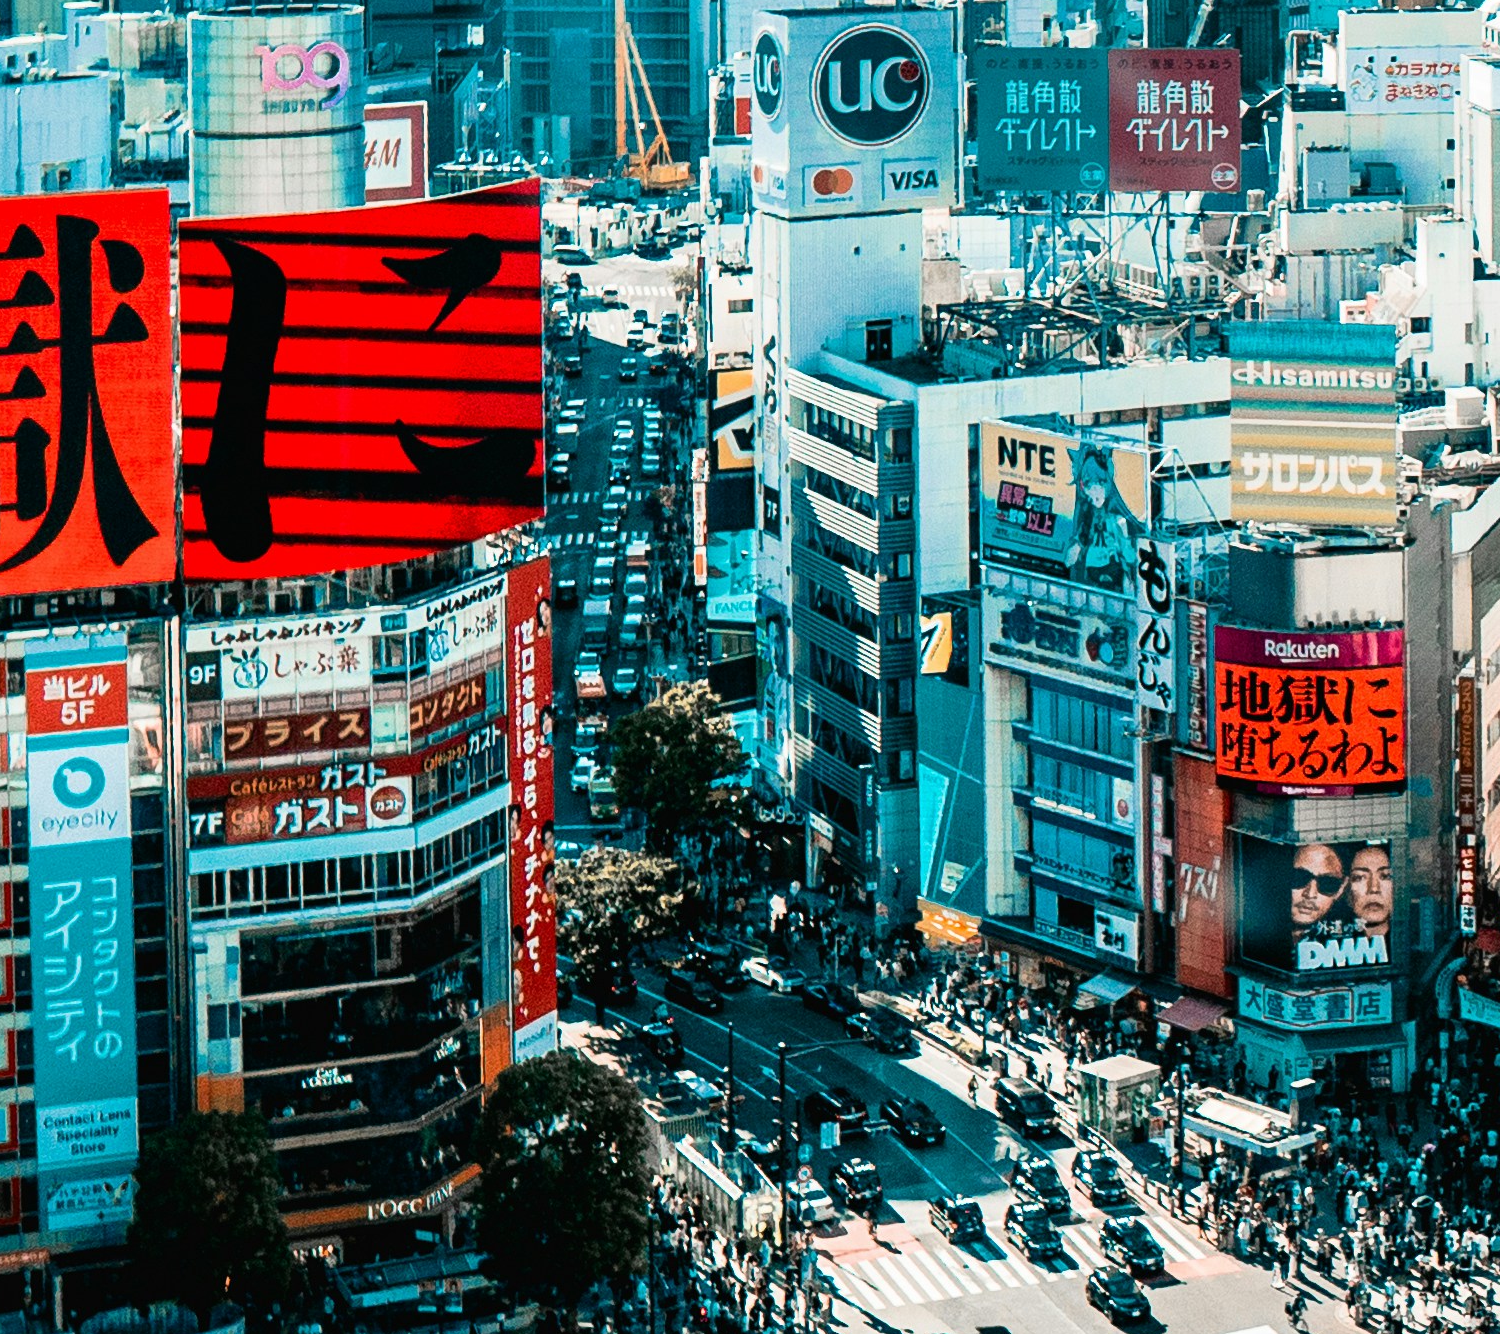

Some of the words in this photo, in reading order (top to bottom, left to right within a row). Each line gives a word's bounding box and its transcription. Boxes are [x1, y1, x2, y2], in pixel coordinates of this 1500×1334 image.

[254, 41, 350, 112] 109
[1395, 62, 1454, 76] カラオケ
[1005, 79, 1082, 115] 龍角散
[1136, 79, 1215, 115] 龍角散
[995, 117, 1097, 152] ダイレクト
[1125, 117, 1231, 152] ダイレクト
[888, 169, 939, 191] VISA
[1232, 360, 1393, 389] Hisamitsu
[205, 231, 540, 564] に
[998, 436, 1056, 478] NTE
[1240, 451, 1387, 496] サロンパス
[210, 617, 366, 647] しゃぶしゃぶバイキング
[453, 603, 498, 647] しゃぶ葉
[1137, 539, 1172, 709] もんじゃ
[274, 644, 362, 679] しゃぶ葉
[1264, 639, 1340, 660] Rakuten
[43, 673, 112, 701] 当ビル
[189, 664, 217, 685] 9F
[60, 699, 96, 725] 5F
[409, 679, 483, 731] コンタクト
[1219, 669, 1398, 726] 地獄に
[226, 710, 366, 752] プライス
[467, 723, 502, 756] ガスト
[1219, 722, 1399, 780] 堕ちるわよ
[320, 762, 387, 792] ガスト
[41, 809, 119, 837] eyecity
[190, 811, 223, 835] 7F
[274, 797, 359, 835] ガスト
[374, 798, 403, 813] ガスト
[92, 874, 123, 1059] コンタクトの
[1297, 934, 1389, 970] DMM
[42, 879, 88, 1063] アイシティ
[1245, 985, 1382, 1021] 大盛堂書店
[43, 1111, 95, 1129] Contact
[98, 1108, 132, 1122] Lens
[70, 1142, 107, 1156] Store
